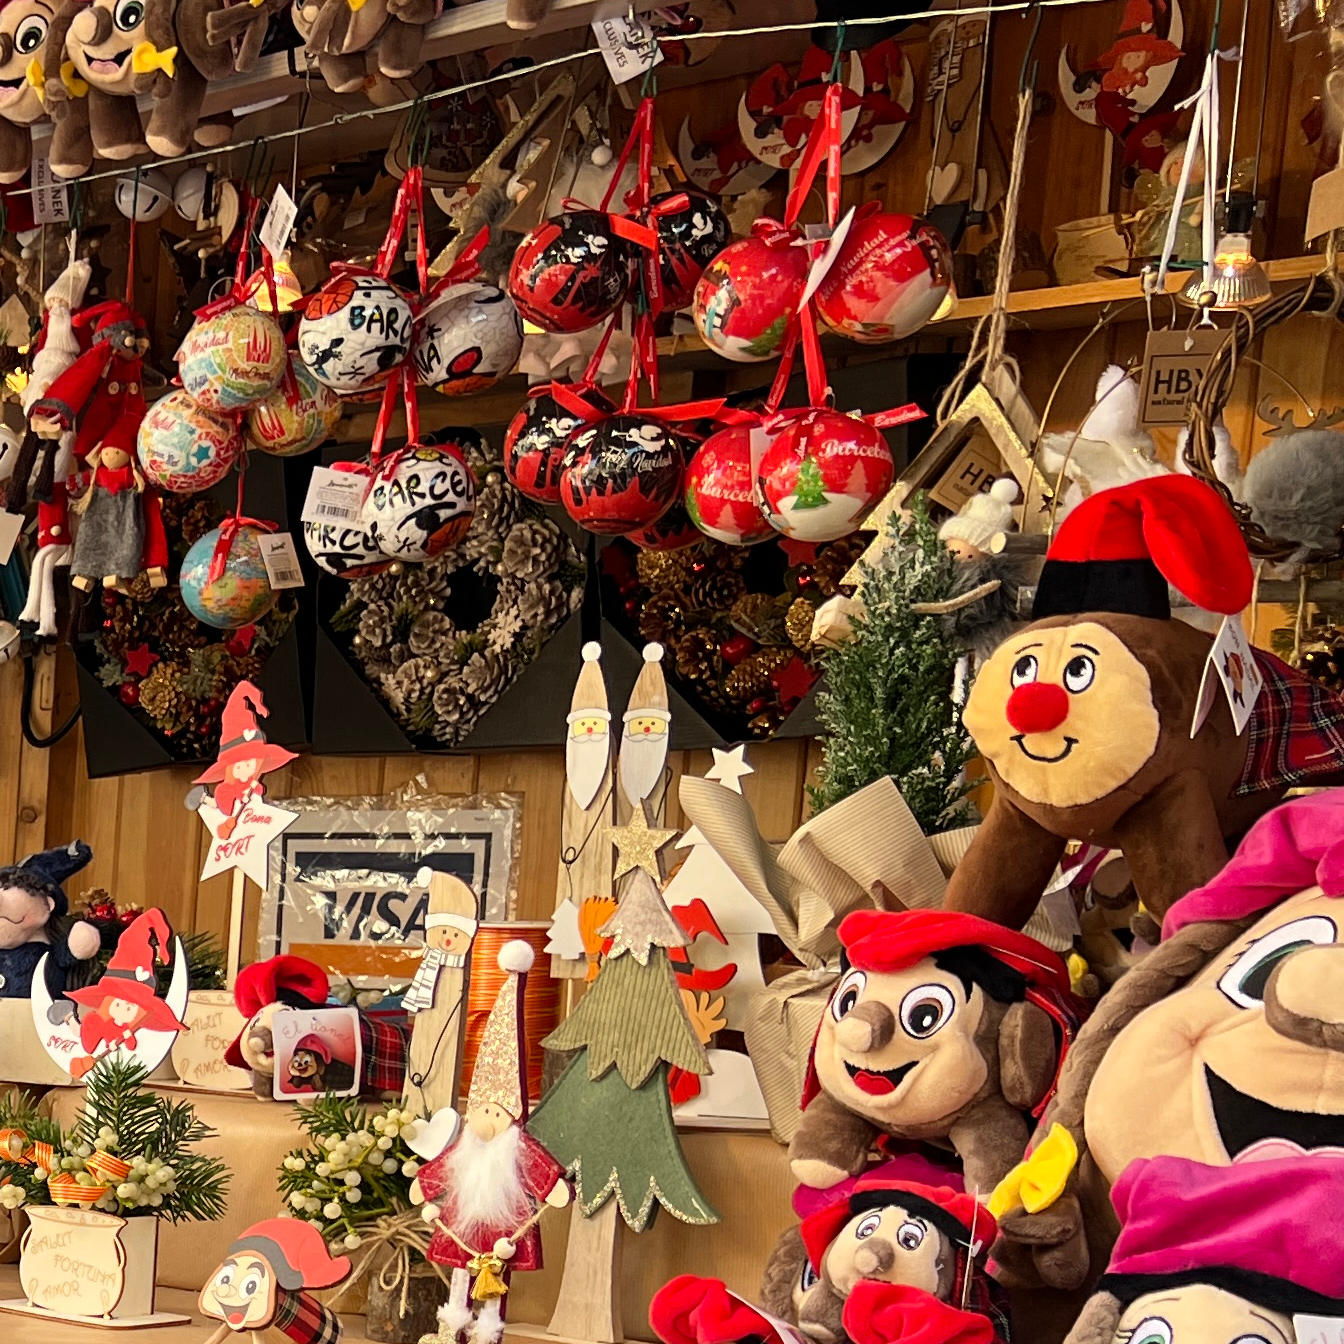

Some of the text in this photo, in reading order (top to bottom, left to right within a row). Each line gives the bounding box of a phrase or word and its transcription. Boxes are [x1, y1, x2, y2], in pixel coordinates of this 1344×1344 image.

[350, 305, 411, 345] BARC
[242, 807, 272, 825] Bona
[214, 834, 256, 863] SORT
[47, 1034, 79, 1052] SORT
[31, 1231, 73, 1255] SALUT
[54, 1254, 117, 1288] FORTUNA
[42, 1280, 81, 1300] AMOR
